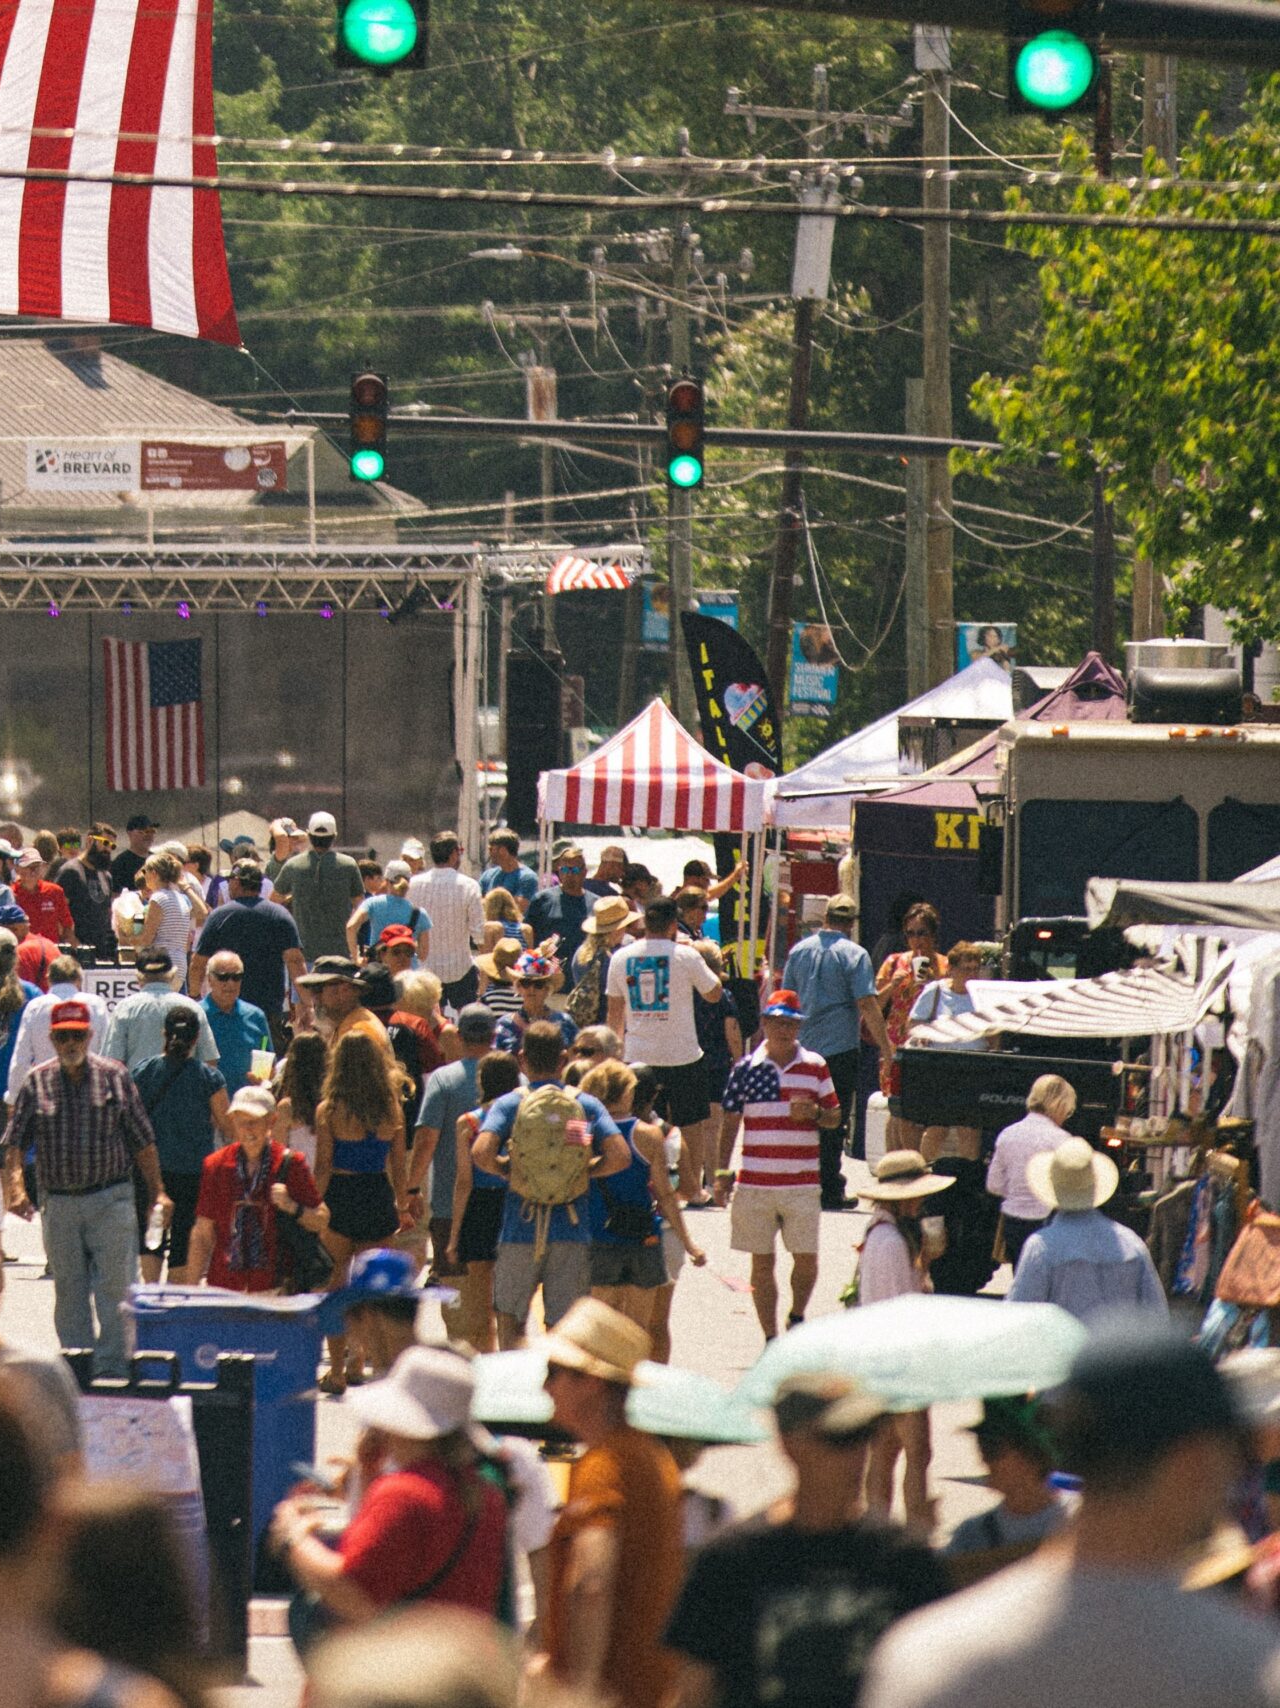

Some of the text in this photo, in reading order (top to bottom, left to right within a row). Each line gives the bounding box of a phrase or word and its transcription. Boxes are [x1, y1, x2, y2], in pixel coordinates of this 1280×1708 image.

[62, 462, 132, 475] BREVARD
[794, 674, 823, 688] MUSIC
[793, 687, 831, 701] FESTIVAL
[700, 641, 731, 769] ITALI
[95, 980, 141, 999] RES
